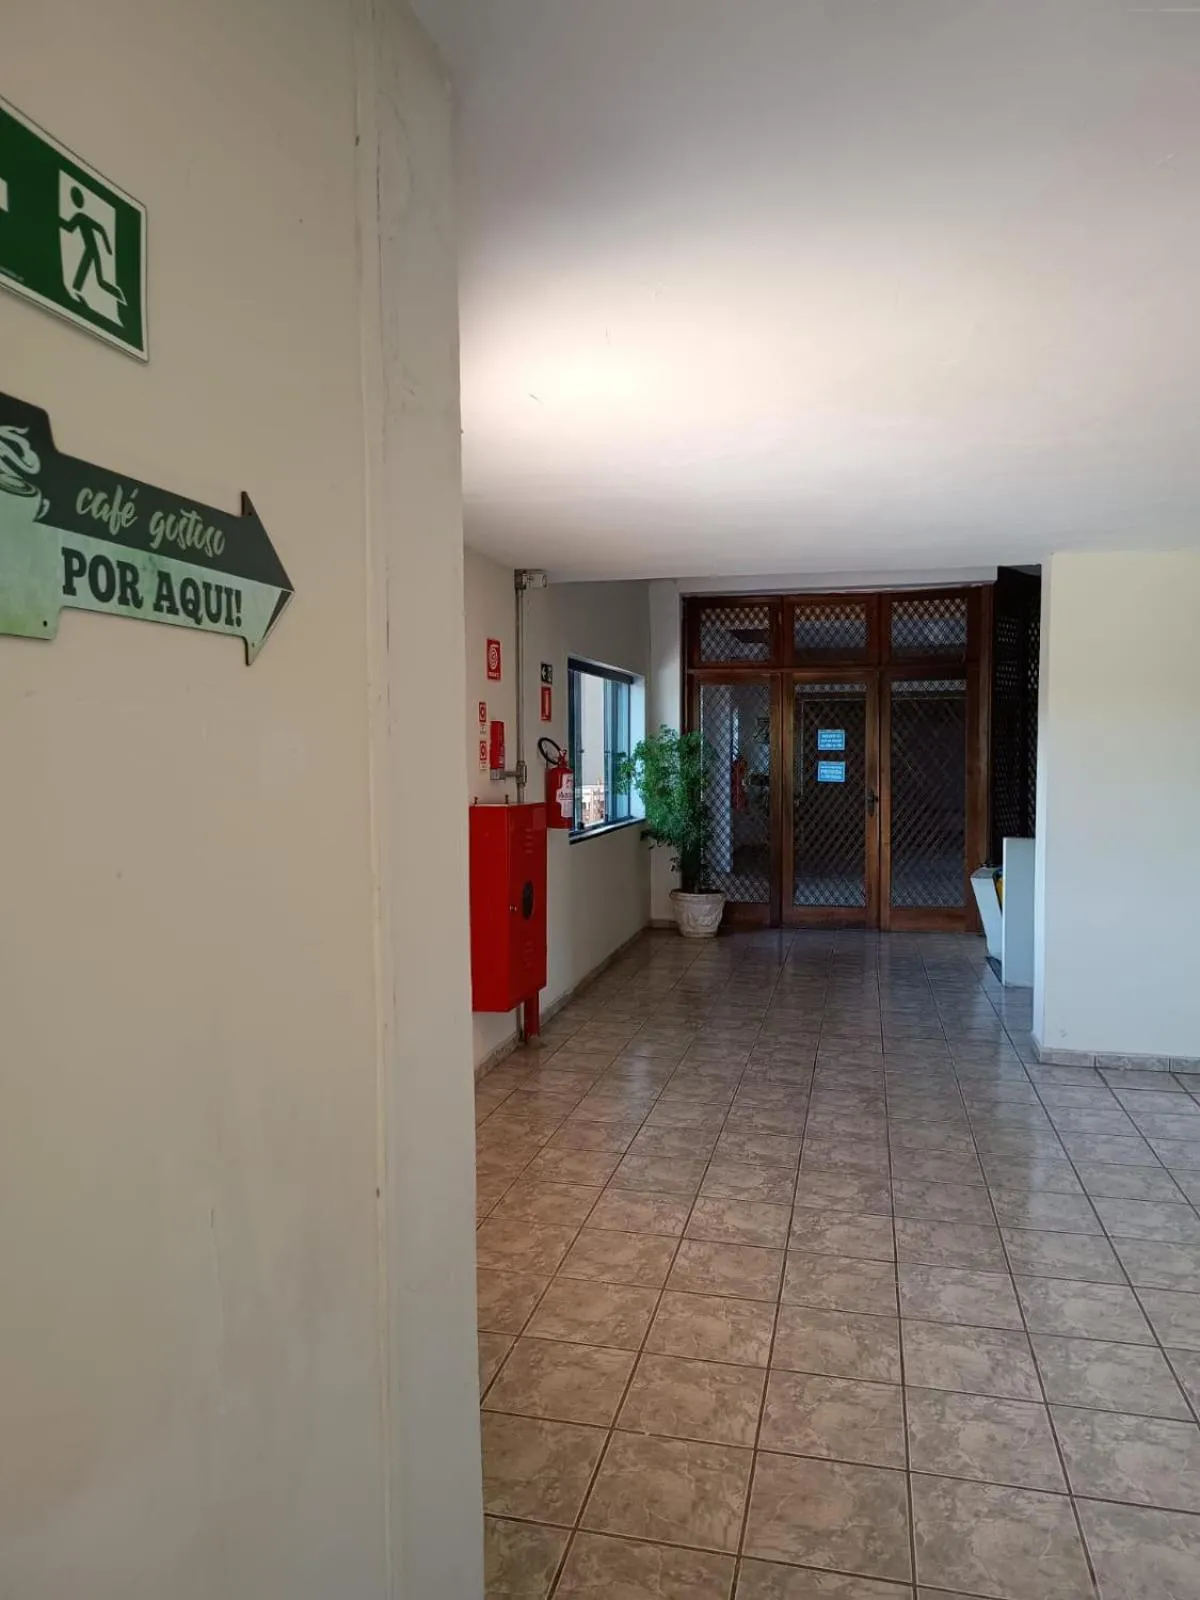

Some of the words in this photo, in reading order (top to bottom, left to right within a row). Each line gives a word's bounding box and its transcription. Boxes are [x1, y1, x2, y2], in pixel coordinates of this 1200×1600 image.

[76, 484, 138, 534] café
[150, 508, 226, 557] gostoso
[61, 546, 143, 609] POR
[153, 570, 243, 627] AQUI!
